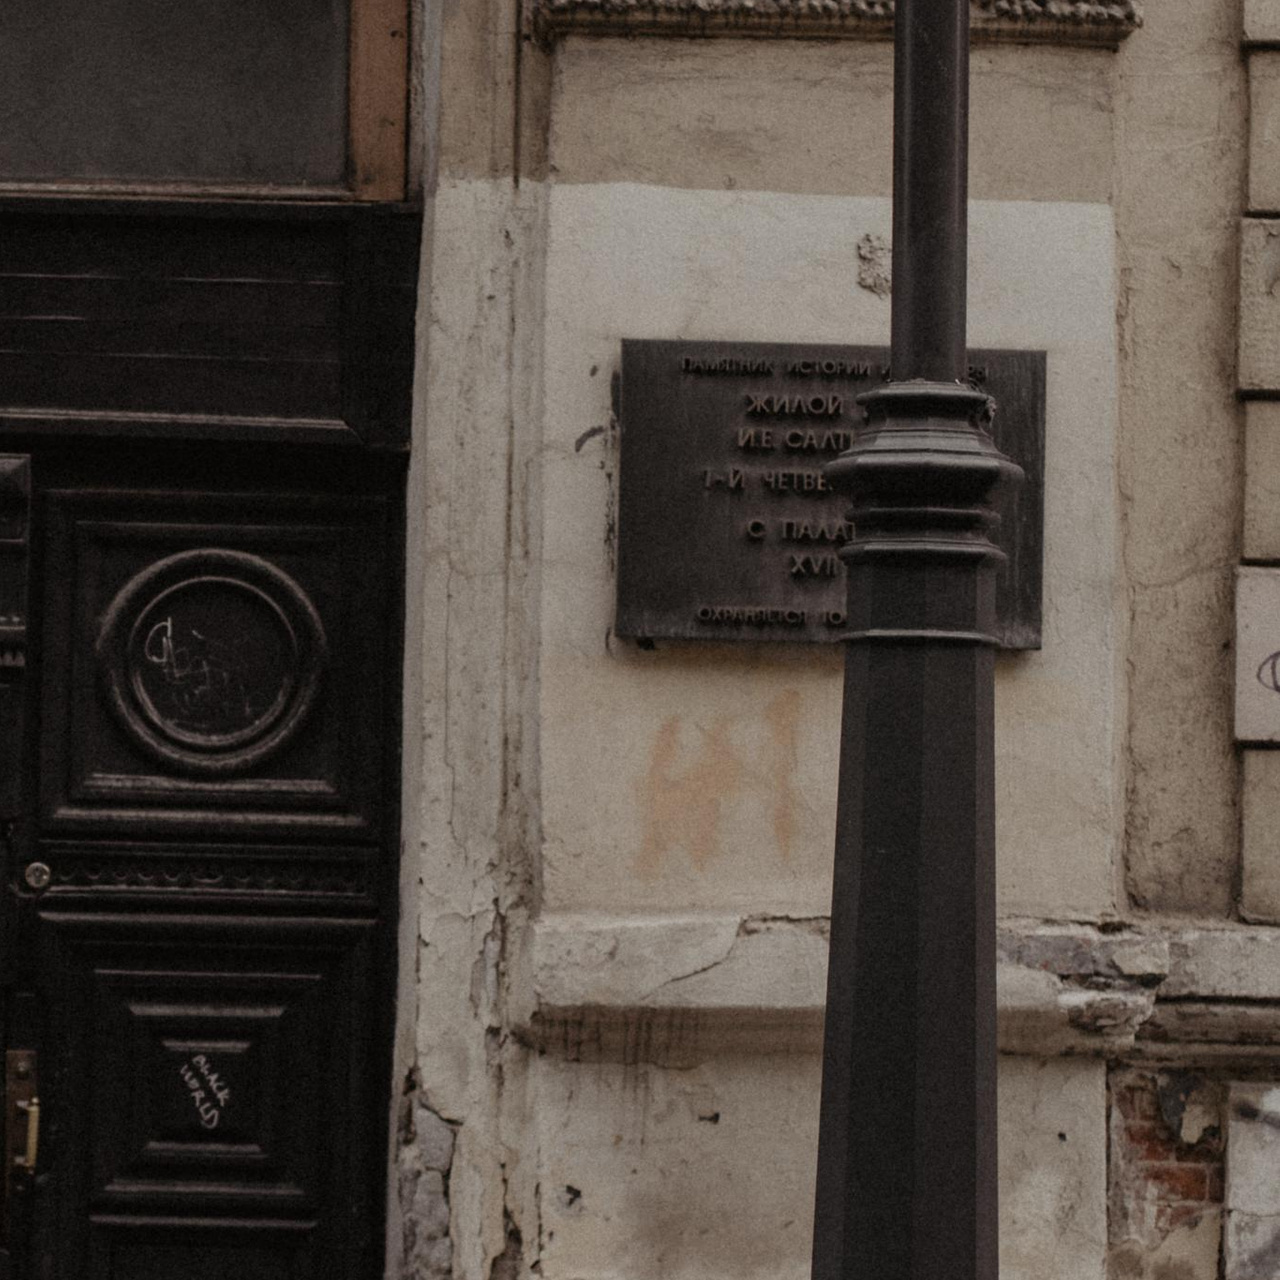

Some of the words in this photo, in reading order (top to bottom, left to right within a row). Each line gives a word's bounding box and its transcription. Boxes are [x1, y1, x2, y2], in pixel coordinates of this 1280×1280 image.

[681, 356, 773, 373] ПАМЯТНИК
[787, 360, 871, 377] ИСТОРИИ
[746, 393, 844, 414] ЖИЛОЙ
[764, 470, 835, 491] ЧЕТВЕ
[747, 519, 767, 537] С
[697, 606, 808, 624] ОХРАНЯЕТСЯ
[192, 1054, 229, 1107] BLACK
[180, 1064, 219, 1129] WORLD
